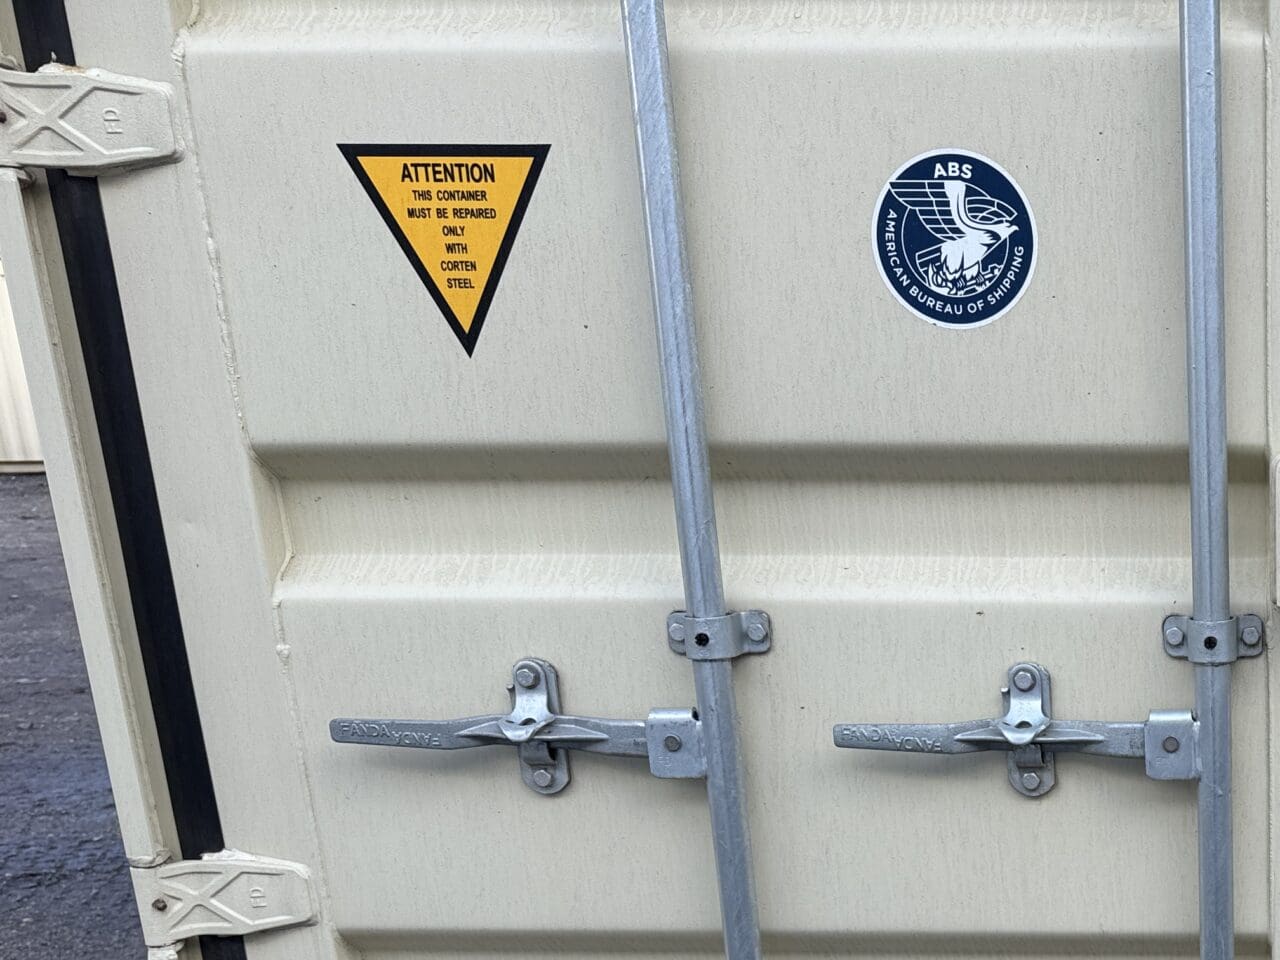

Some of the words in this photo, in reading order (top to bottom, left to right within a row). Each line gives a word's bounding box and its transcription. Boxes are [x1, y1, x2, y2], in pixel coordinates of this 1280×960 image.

[401, 163, 495, 183] ATTENTION
[934, 162, 972, 179] ABS
[412, 190, 432, 201] THIS
[437, 190, 487, 201] CONTAINER
[407, 208, 431, 218] MUST
[436, 208, 448, 218] BE
[453, 208, 496, 219] REPAIRED
[442, 226, 465, 236] ONLY
[445, 243, 467, 254] WITH
[441, 261, 476, 271] CORTEN
[885, 208, 910, 286] AMERICAN
[909, 286, 962, 314] BUREAU
[967, 300, 985, 313] OF
[987, 246, 1024, 305] SHIPPING
[447, 278, 475, 288] STEEL
